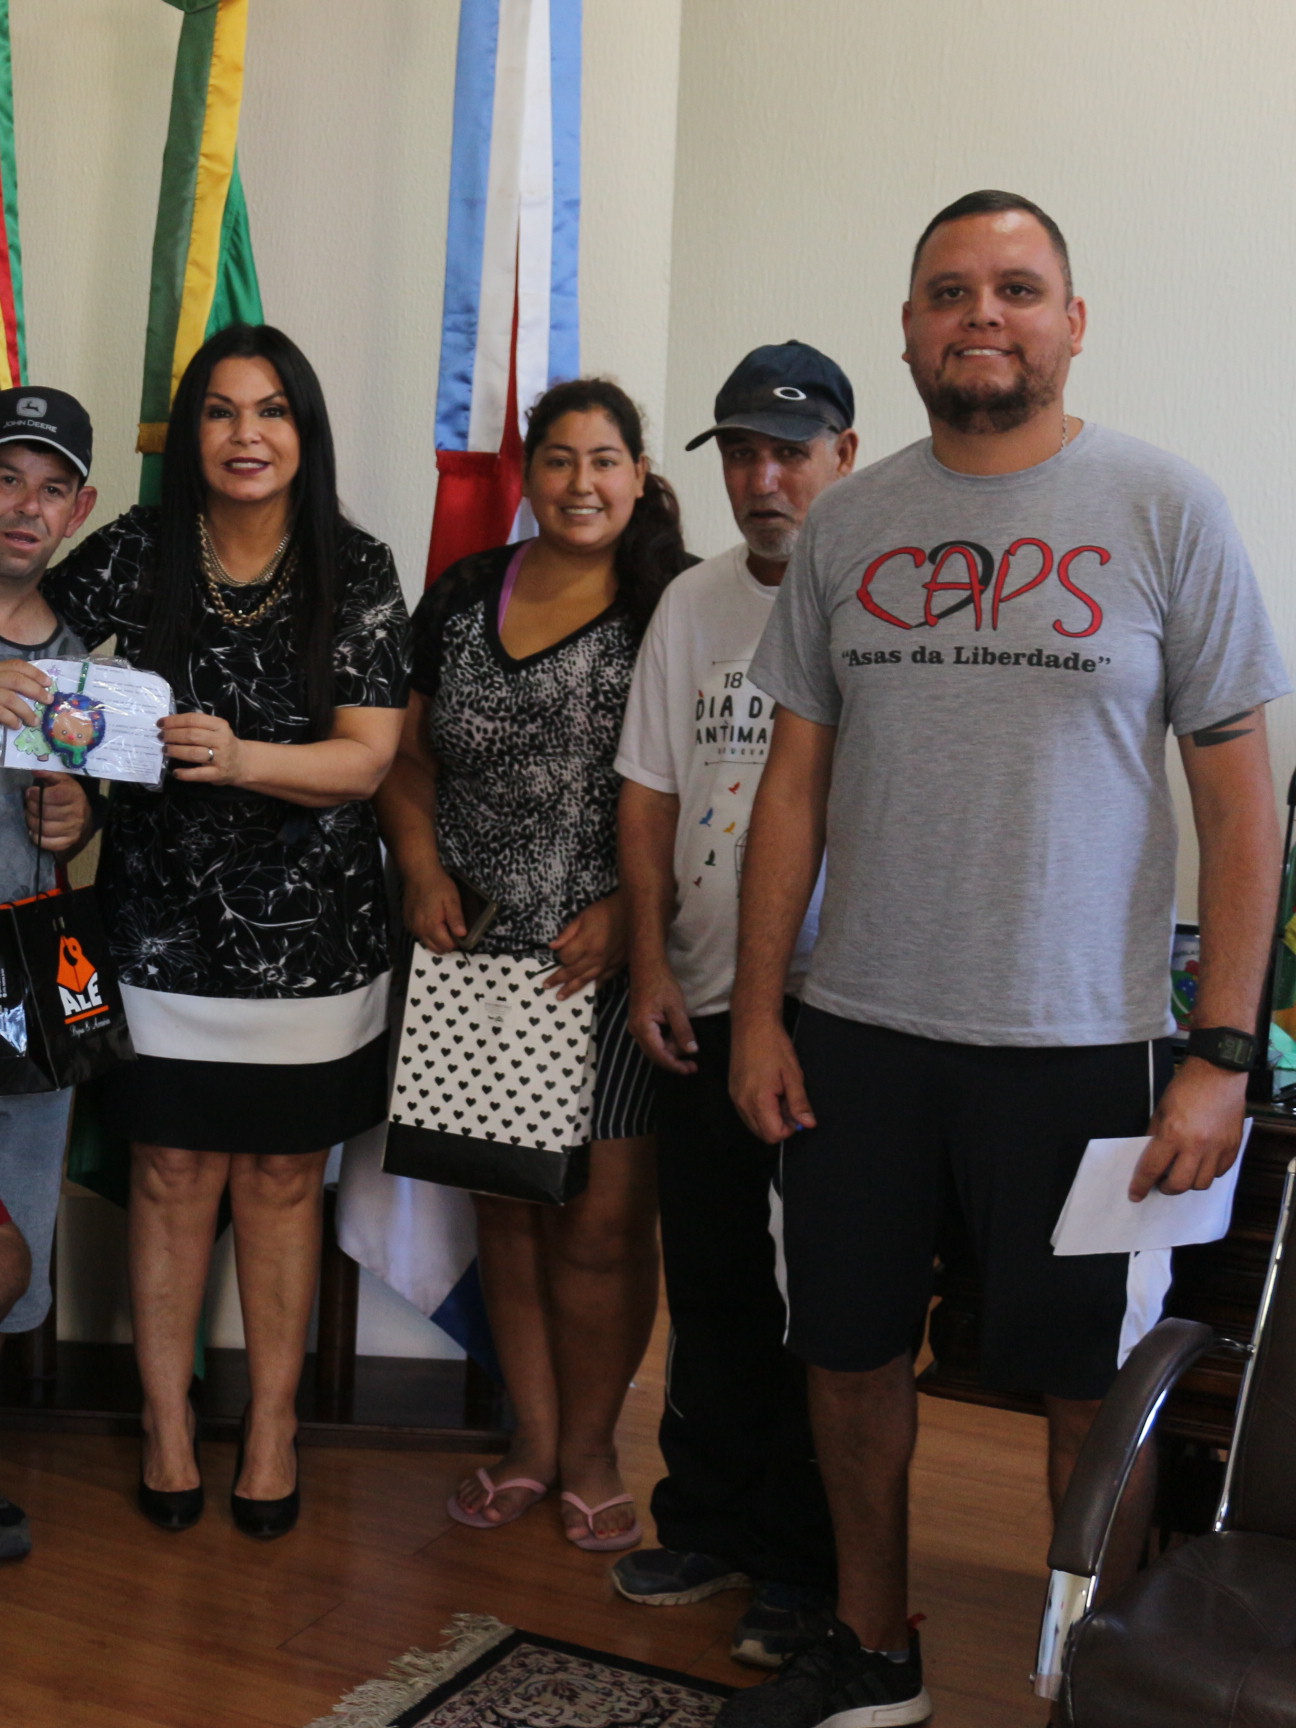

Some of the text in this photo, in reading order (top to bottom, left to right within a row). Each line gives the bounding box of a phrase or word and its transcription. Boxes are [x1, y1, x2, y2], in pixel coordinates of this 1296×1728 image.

[3, 419, 58, 433] JOHN DEERE
[856, 537, 1112, 638] CAPS
[911, 646, 944, 665] da
[723, 671, 744, 689] 18
[695, 695, 733, 721] DIA
[58, 971, 103, 1017] ALE
